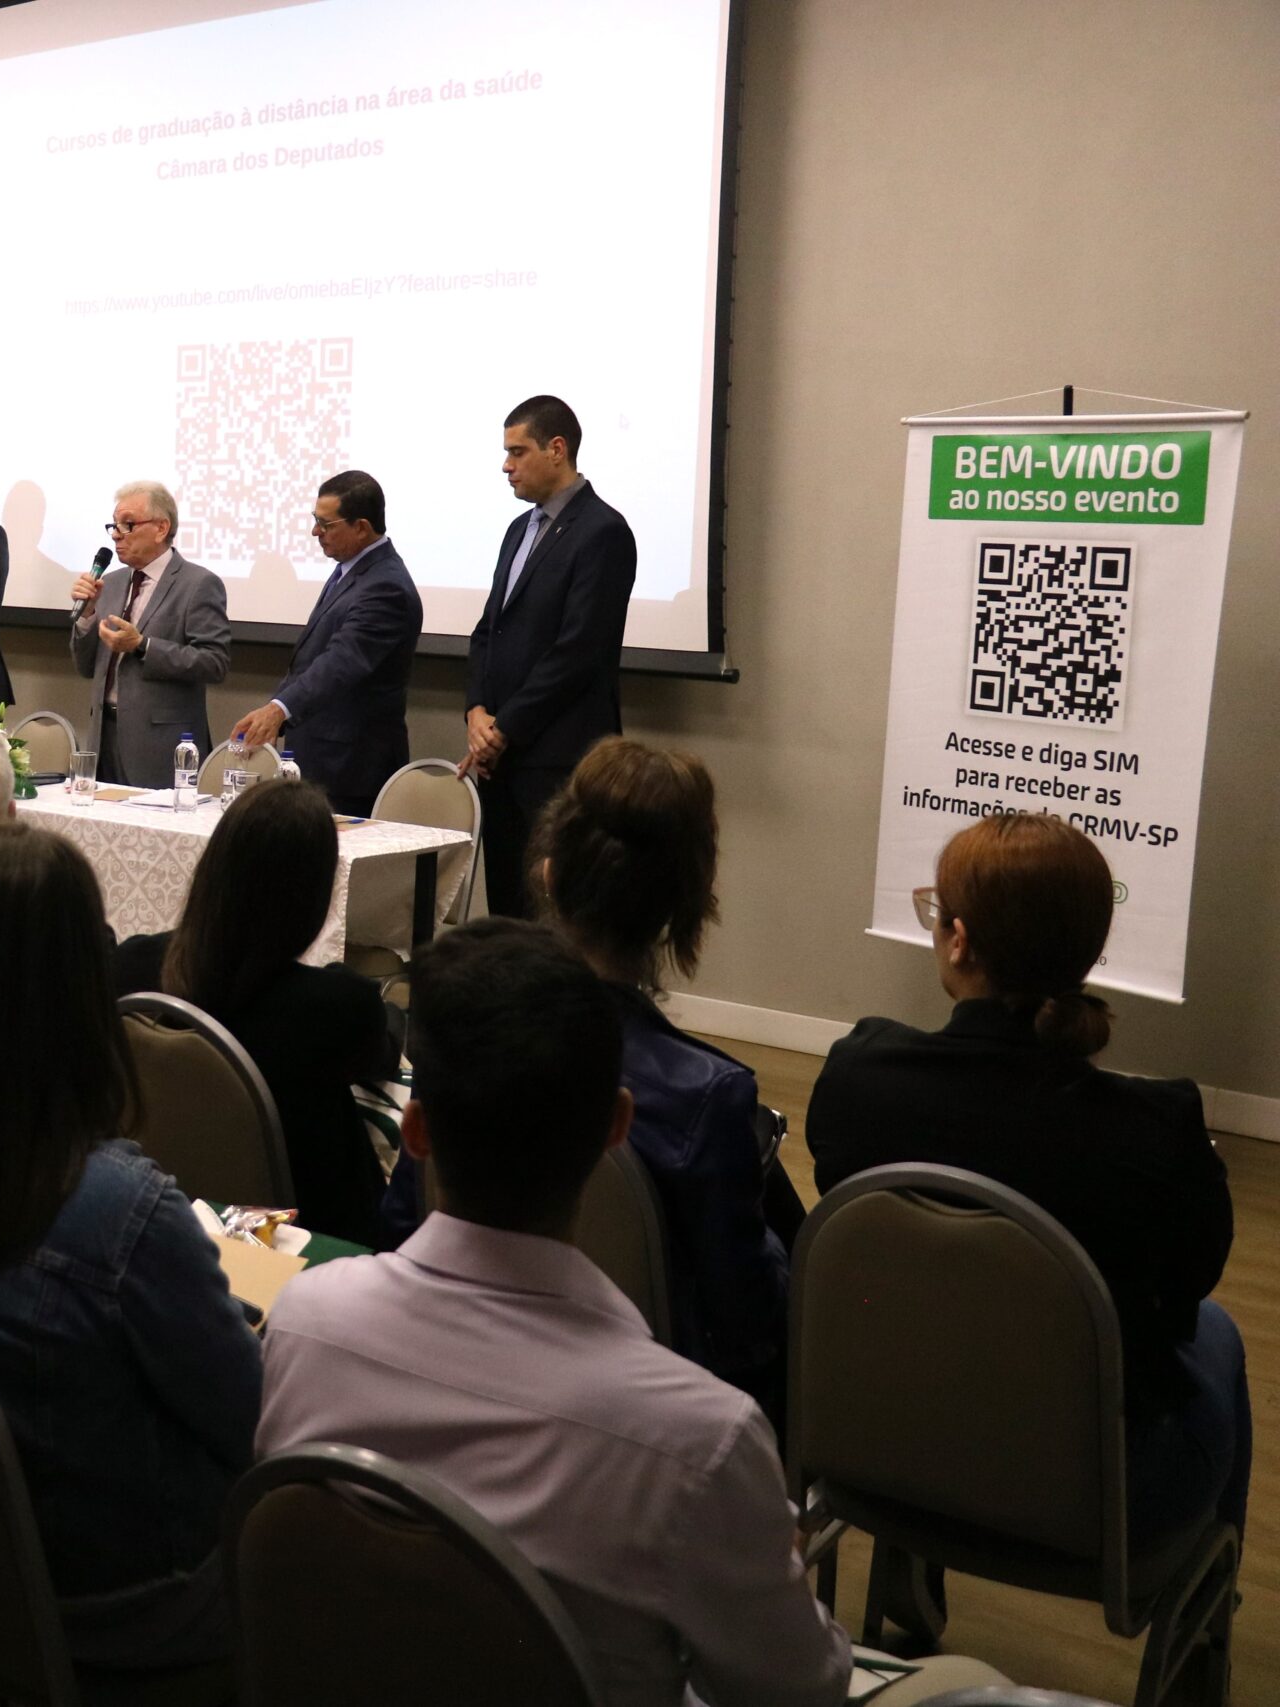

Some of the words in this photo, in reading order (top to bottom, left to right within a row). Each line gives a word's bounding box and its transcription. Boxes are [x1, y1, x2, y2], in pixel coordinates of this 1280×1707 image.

[45, 131, 107, 154] Cursos
[111, 125, 134, 146] de
[139, 112, 235, 144] graduação
[240, 106, 253, 128] à
[258, 95, 348, 125] distância
[354, 94, 381, 113] na
[385, 85, 434, 108] área
[439, 78, 467, 102] da
[473, 69, 543, 96] saúde
[156, 155, 228, 181] Câmara
[232, 150, 269, 173] dos
[275, 137, 384, 168] Deputados
[954, 443, 1182, 480] BEM-VINDO
[949, 488, 979, 510] ao
[986, 488, 1067, 511] nosso
[1074, 486, 1180, 514] evento
[944, 731, 1017, 760] Acesse
[1021, 744, 1034, 762] e
[1039, 743, 1088, 771] diga
[1093, 750, 1140, 775] SIM
[955, 765, 1000, 789] para
[1005, 773, 1091, 803] receber
[1095, 785, 1122, 806] as
[1069, 813, 1179, 847] CRMV-SP
